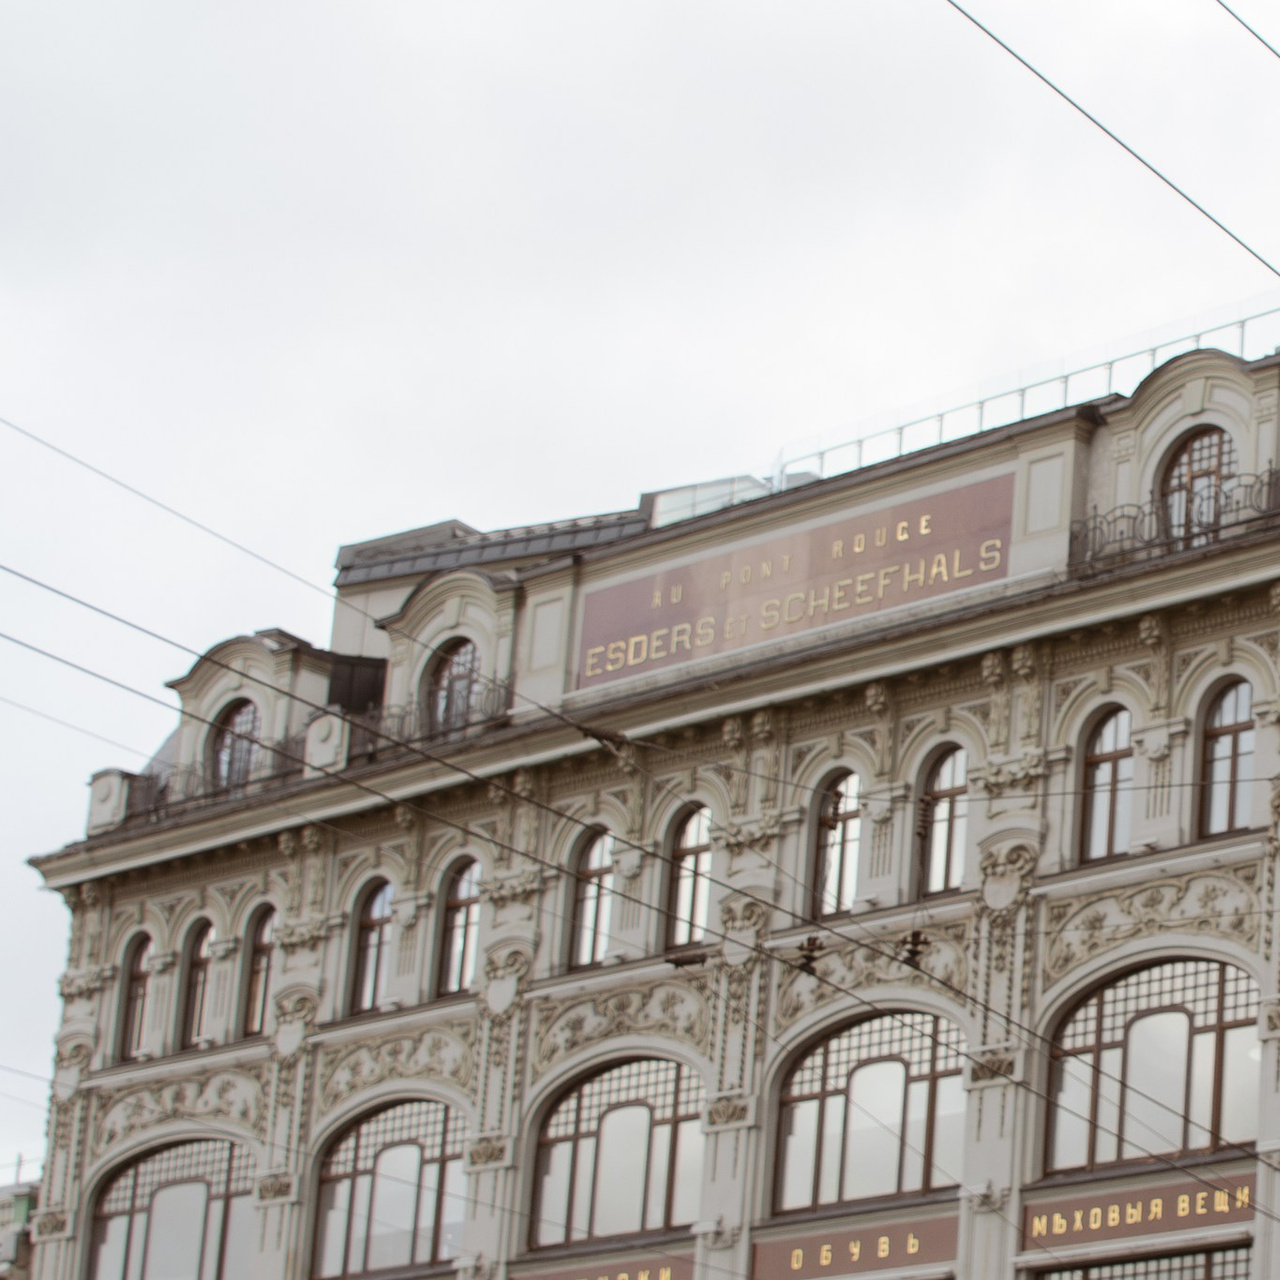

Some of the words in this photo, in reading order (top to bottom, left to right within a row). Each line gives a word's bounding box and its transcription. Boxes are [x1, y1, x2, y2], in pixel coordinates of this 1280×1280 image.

[651, 584, 684, 609] AU
[719, 553, 793, 590] PONT
[831, 514, 932, 559] ROUGE
[584, 616, 716, 678] ESDERS
[760, 538, 1003, 632] SCHEEFHALS
[1176, 1184, 1250, 1219] ВЕЩИ
[790, 1232, 920, 1271] ОБУВЬ
